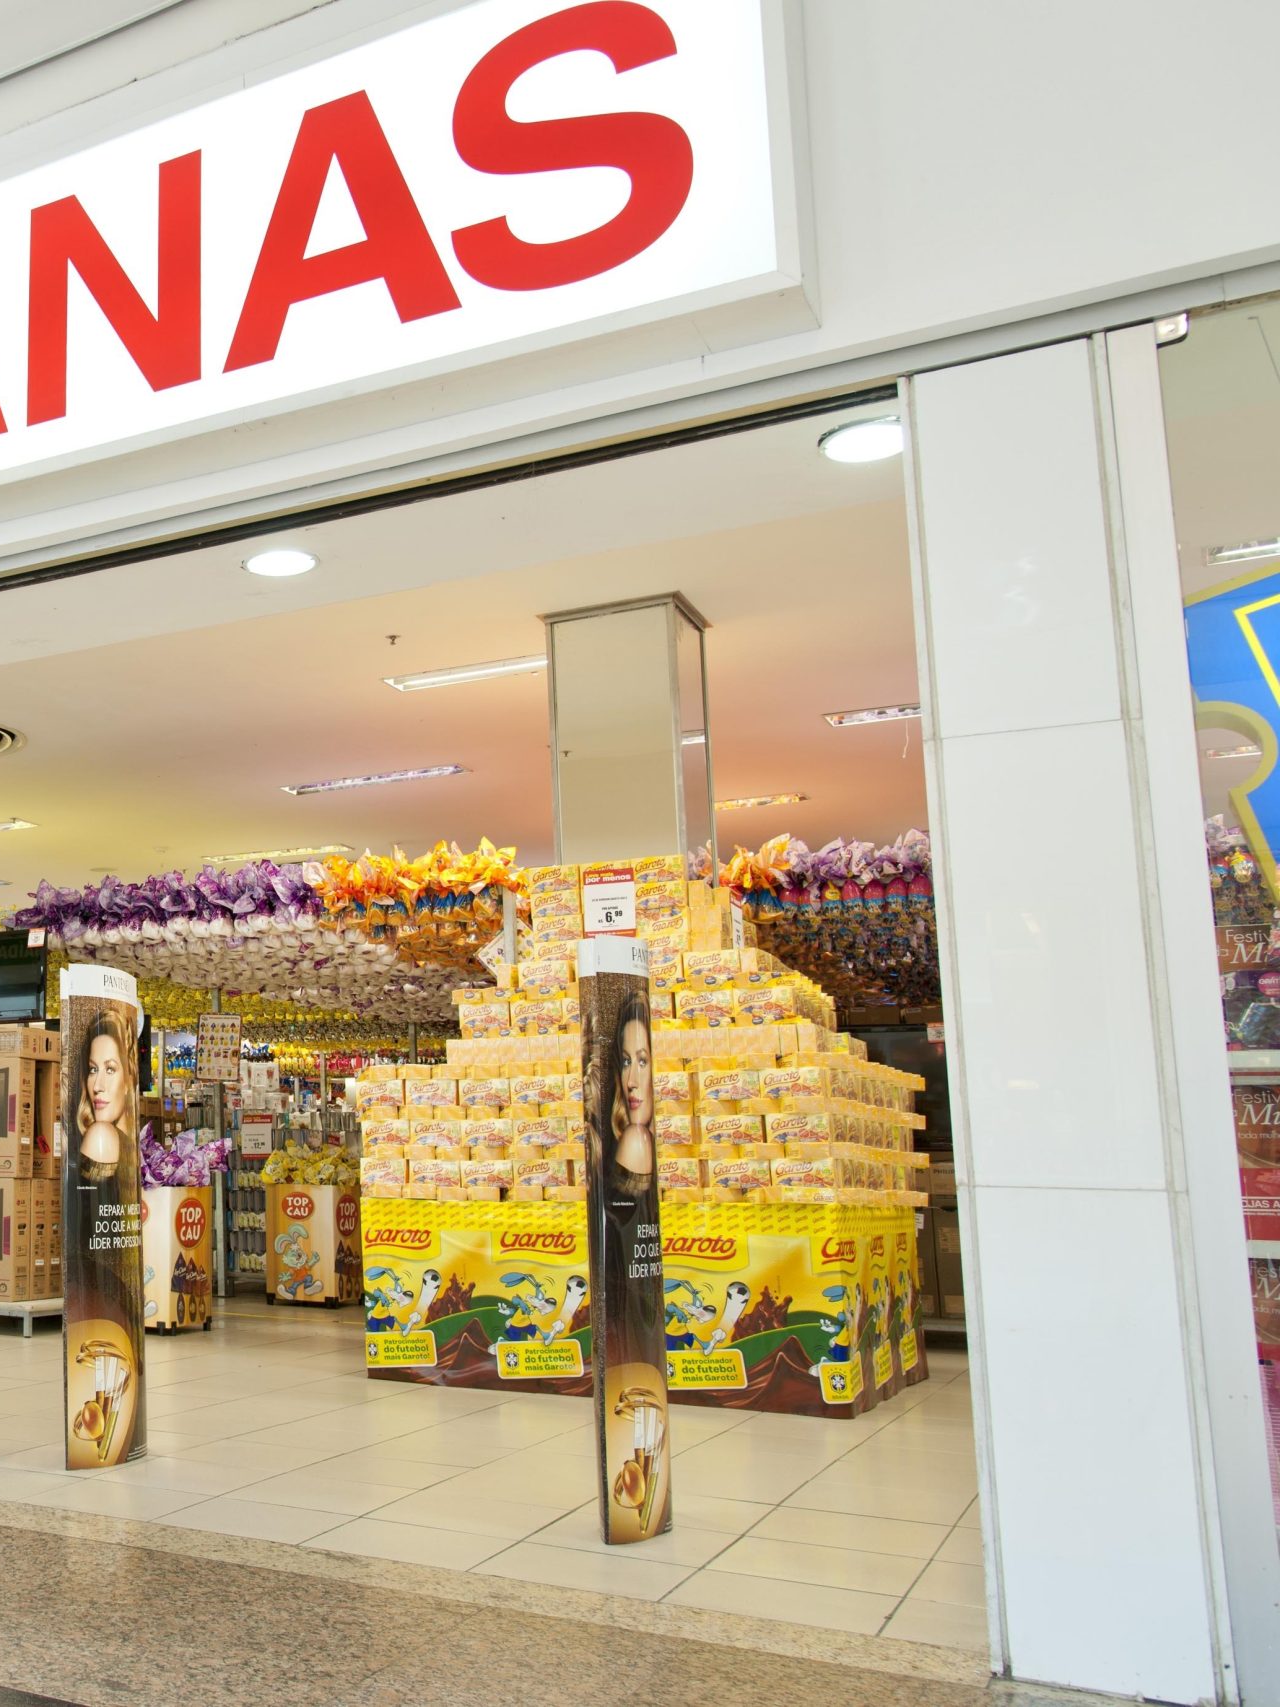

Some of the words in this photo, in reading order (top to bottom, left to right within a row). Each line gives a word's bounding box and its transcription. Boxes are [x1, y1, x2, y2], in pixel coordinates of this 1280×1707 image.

[603, 874, 631, 882] menos
[704, 1072, 740, 1089] Garoto
[706, 1118, 743, 1134] Garoto
[658, 1161, 679, 1174] roto
[713, 1160, 750, 1178] Garoto
[776, 1160, 814, 1178] Garoto
[286, 1197, 309, 1207] TOP
[1241, 1200, 1270, 1209] OJAS
[180, 1207, 202, 1224] TOP
[286, 1207, 309, 1217] CAU
[339, 1203, 356, 1217] TOP
[95, 1221, 110, 1233] DO
[111, 1220, 126, 1233] QUE
[340, 1217, 356, 1231] CAU
[180, 1225, 200, 1241] CAU
[365, 1227, 432, 1250] Garoto
[89, 1234, 111, 1250] LÍDER
[500, 1231, 576, 1255] Garoto
[662, 1234, 737, 1261] aroto
[634, 1244, 647, 1258] DO
[648, 1243, 659, 1257] QUE
[629, 1261, 649, 1278] LÍDER
[397, 1344, 429, 1353] futebol
[525, 1347, 571, 1355] Patrocinador
[537, 1354, 575, 1363] futebol
[682, 1357, 733, 1365] Patrocinador
[682, 1365, 695, 1374] do
[697, 1365, 737, 1373] futebol
